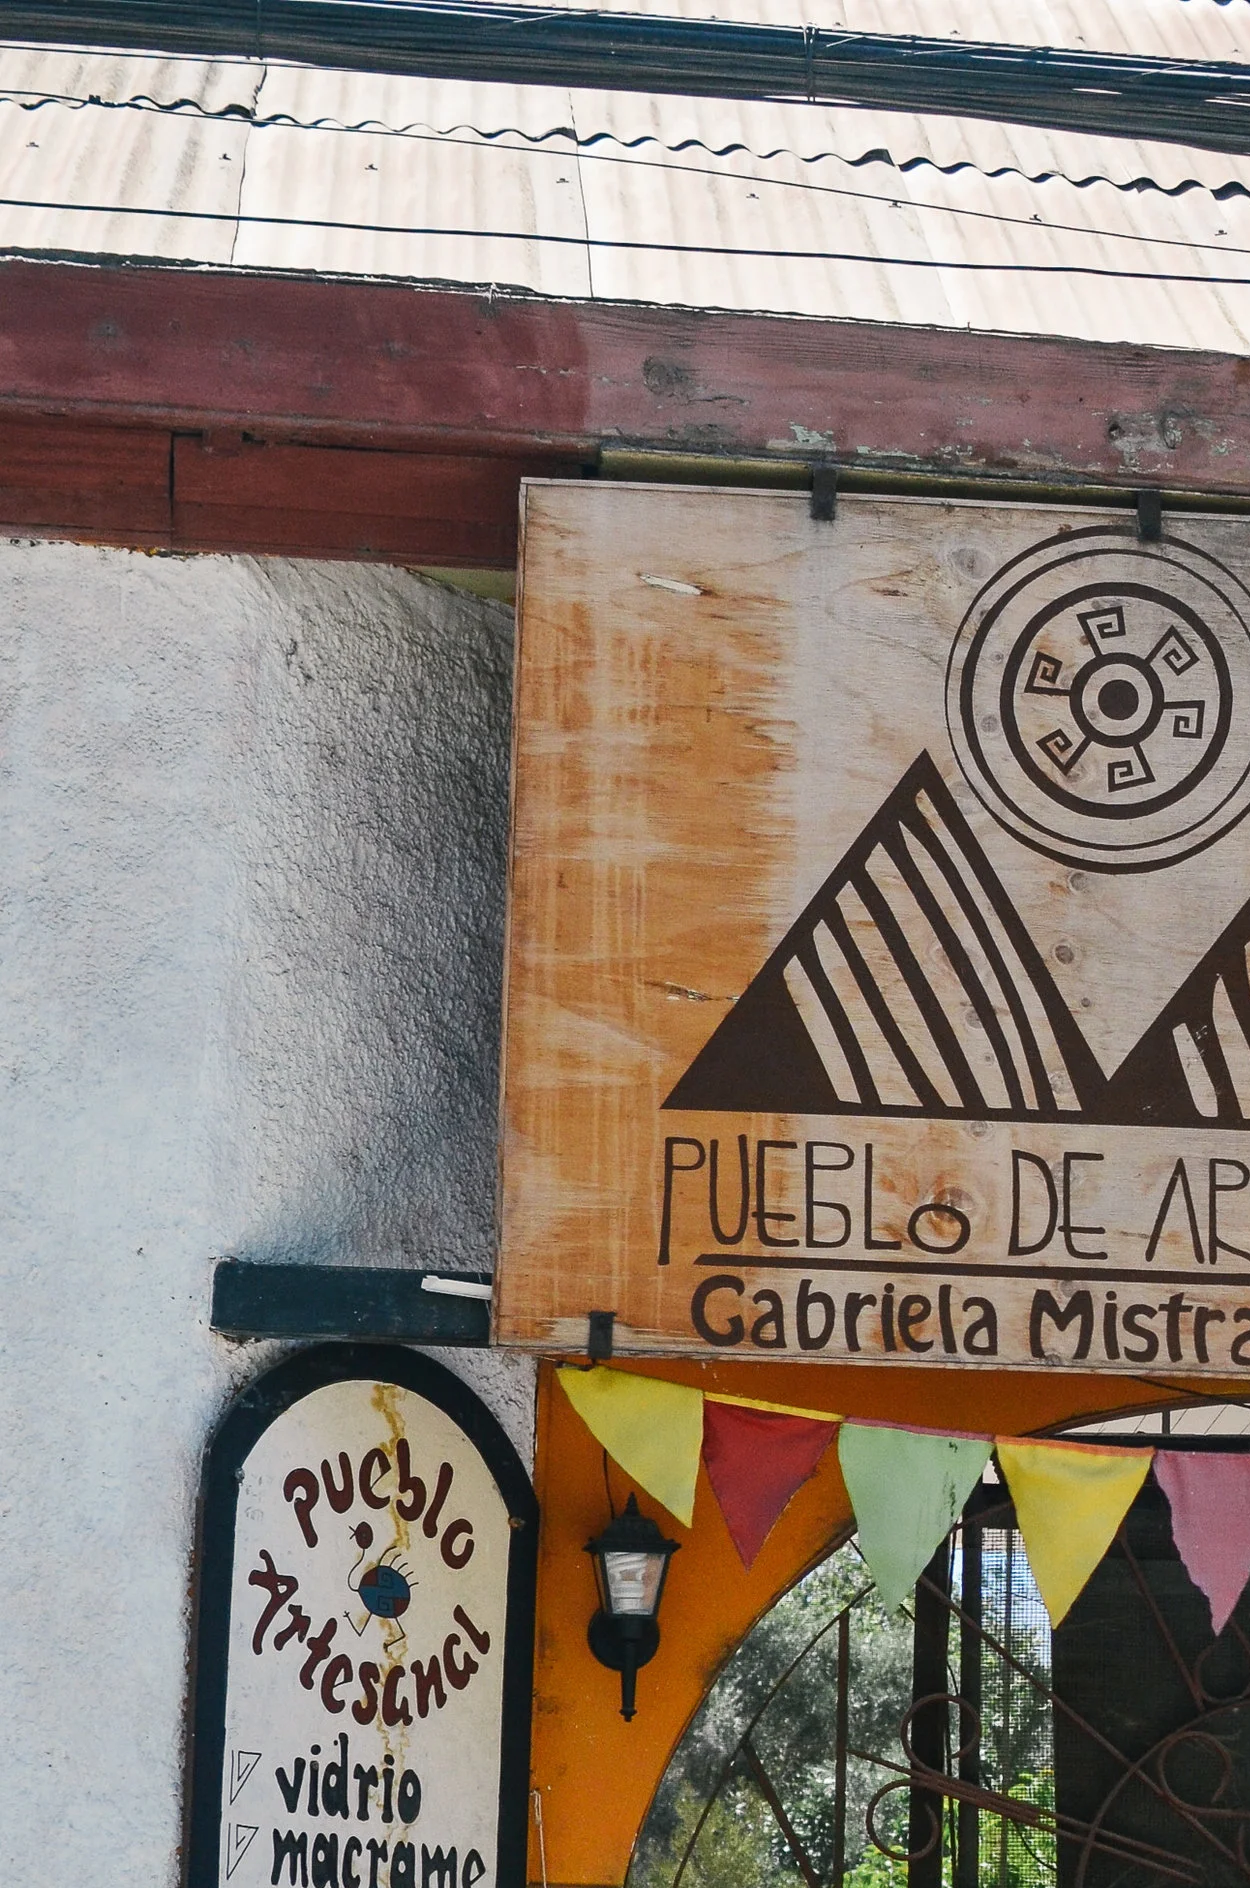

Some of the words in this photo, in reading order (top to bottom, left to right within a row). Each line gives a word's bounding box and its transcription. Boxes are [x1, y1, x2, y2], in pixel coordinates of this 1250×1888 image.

[658, 1134, 971, 1265] PUEBLO
[1007, 1148, 1108, 1260] DE
[691, 1274, 998, 1356] Gabriela
[248, 1549, 491, 1726] Artesanal
[275, 1732, 422, 1824] vidrio
